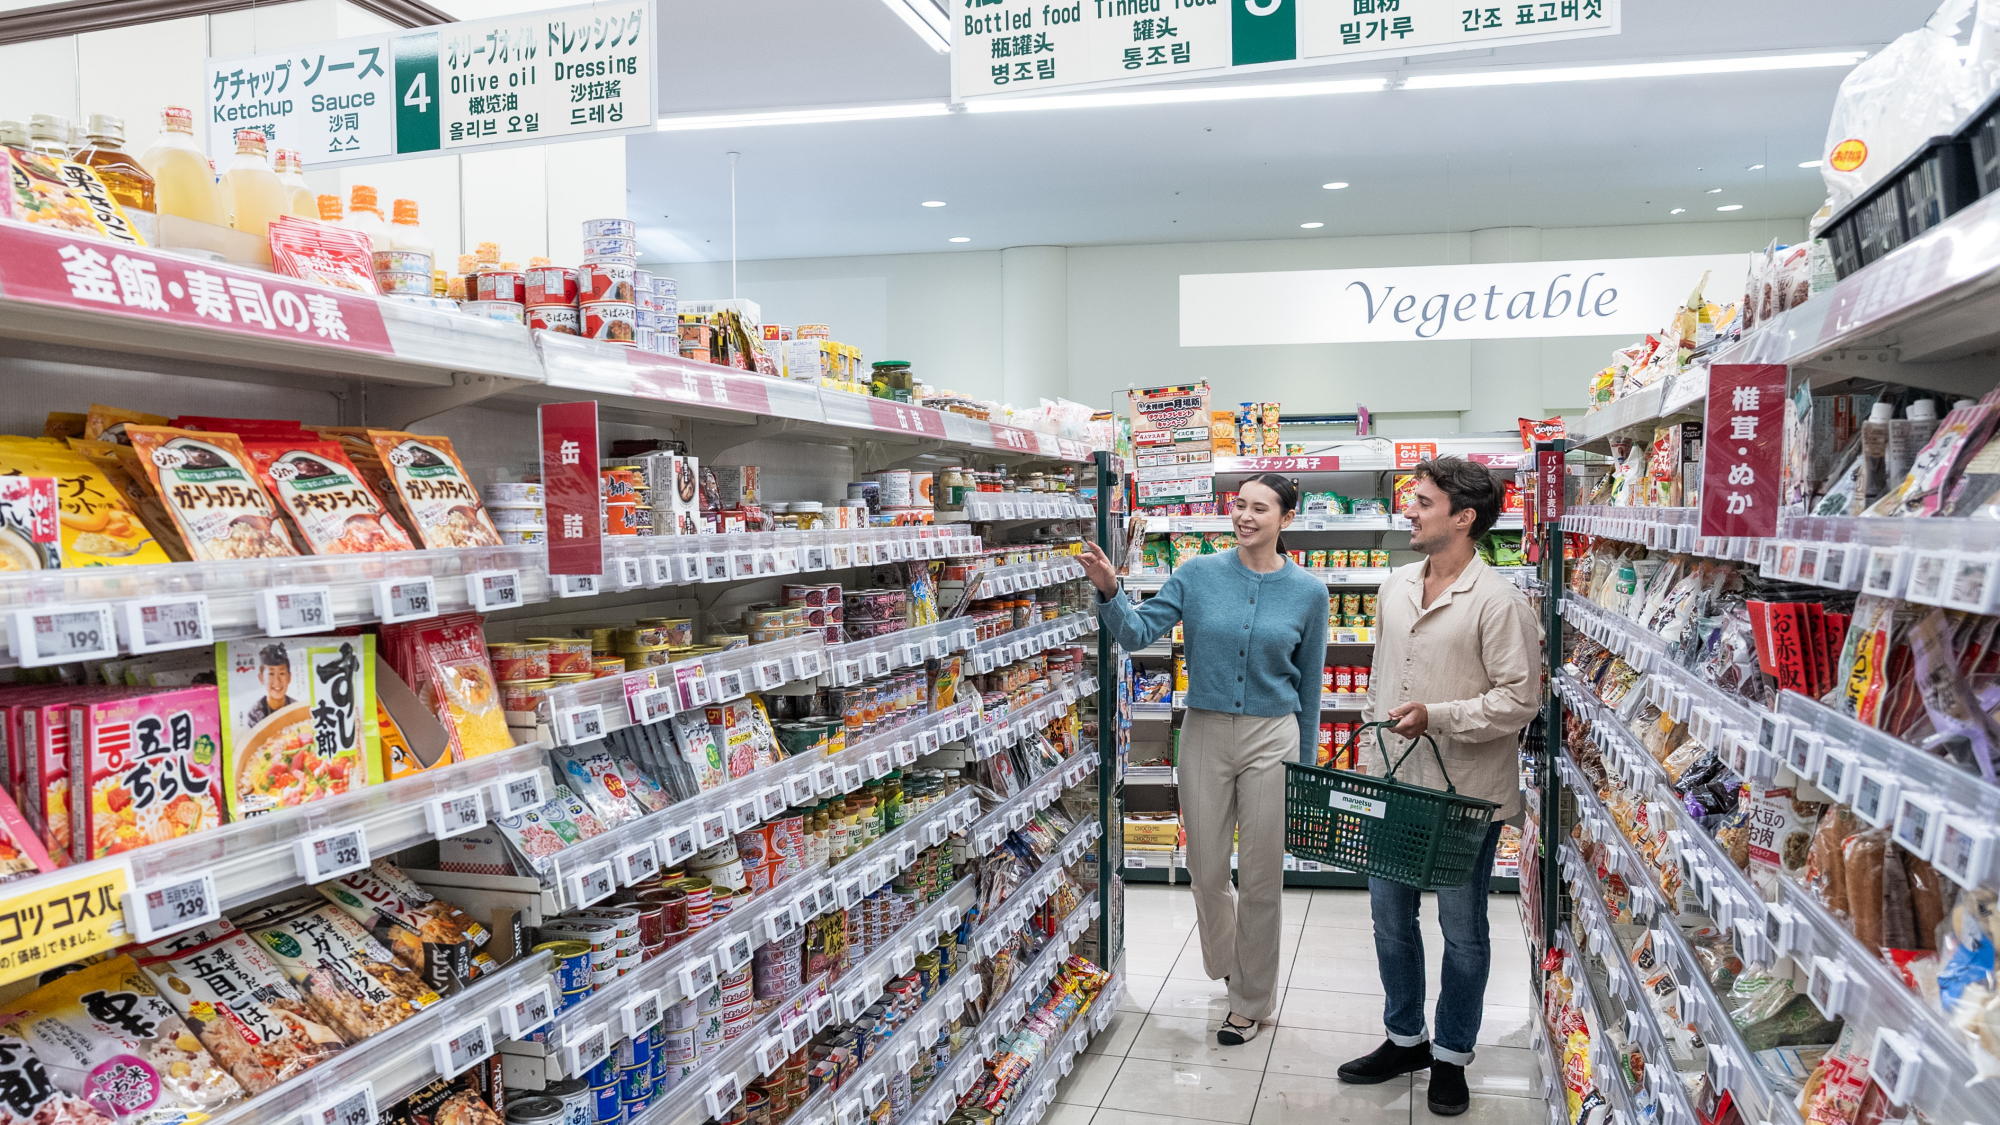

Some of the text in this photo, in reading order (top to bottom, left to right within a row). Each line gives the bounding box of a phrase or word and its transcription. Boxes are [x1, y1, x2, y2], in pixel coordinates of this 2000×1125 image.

[965, 0, 1080, 36] Bottled food
[1133, 16, 1178, 42] 罐头
[1340, 16, 1414, 45] 밀가루
[1461, 8, 1502, 32] 간조
[548, 9, 643, 57] ドレッシング
[992, 32, 1054, 59] 瓶罐头
[448, 25, 538, 71] オリーブオイル
[1122, 41, 1190, 70] 통조림
[213, 47, 385, 102] ケチャップ ソース
[451, 66, 536, 94] Olive oil
[555, 56, 637, 81] Dressing
[992, 58, 1055, 85] 병조림
[404, 72, 431, 113] 4
[469, 93, 518, 116] 橄览油
[570, 80, 622, 103] 沙拉酱
[214, 92, 375, 123] Ketchup Sauce
[570, 103, 623, 125] 드레싱
[329, 113, 359, 132] 沙司
[449, 113, 539, 141] 올리브 오일
[329, 135, 360, 152] 소스
[58, 245, 351, 342] 釜飯・寿司の素
[1345, 273, 1619, 339] Vegetable
[1249, 457, 1321, 470] スナック菓子
[1726, 386, 1760, 515] 椎茸・ぬか
[560, 440, 583, 539] 缶詰
[1547, 456, 1557, 518] パン粉・小麦粉
[292, 489, 372, 516] チキンライス
[410, 596, 428, 610] 159
[499, 588, 515, 600] 159
[174, 620, 198, 637] 119
[300, 608, 322, 623] 159
[68, 630, 99, 648] 199
[1773, 610, 1803, 689] お赤飯
[312, 642, 361, 760] すし 太郎
[136, 712, 193, 760] 五目
[122, 755, 210, 809] ちらし
[521, 788, 537, 802] 179
[1342, 795, 1372, 807] maruetsu
[459, 809, 477, 823] 169
[1750, 807, 1785, 830] 大豆の
[1749, 826, 1774, 848] お肉
[337, 847, 358, 864] 329
[176, 898, 204, 918] 239
[288, 919, 391, 1004] 牛ガーリック飯
[184, 954, 283, 1044] 五目ごはん
[531, 1004, 546, 1019] 199
[467, 1039, 484, 1054] 199
[346, 1108, 367, 1125] 199
